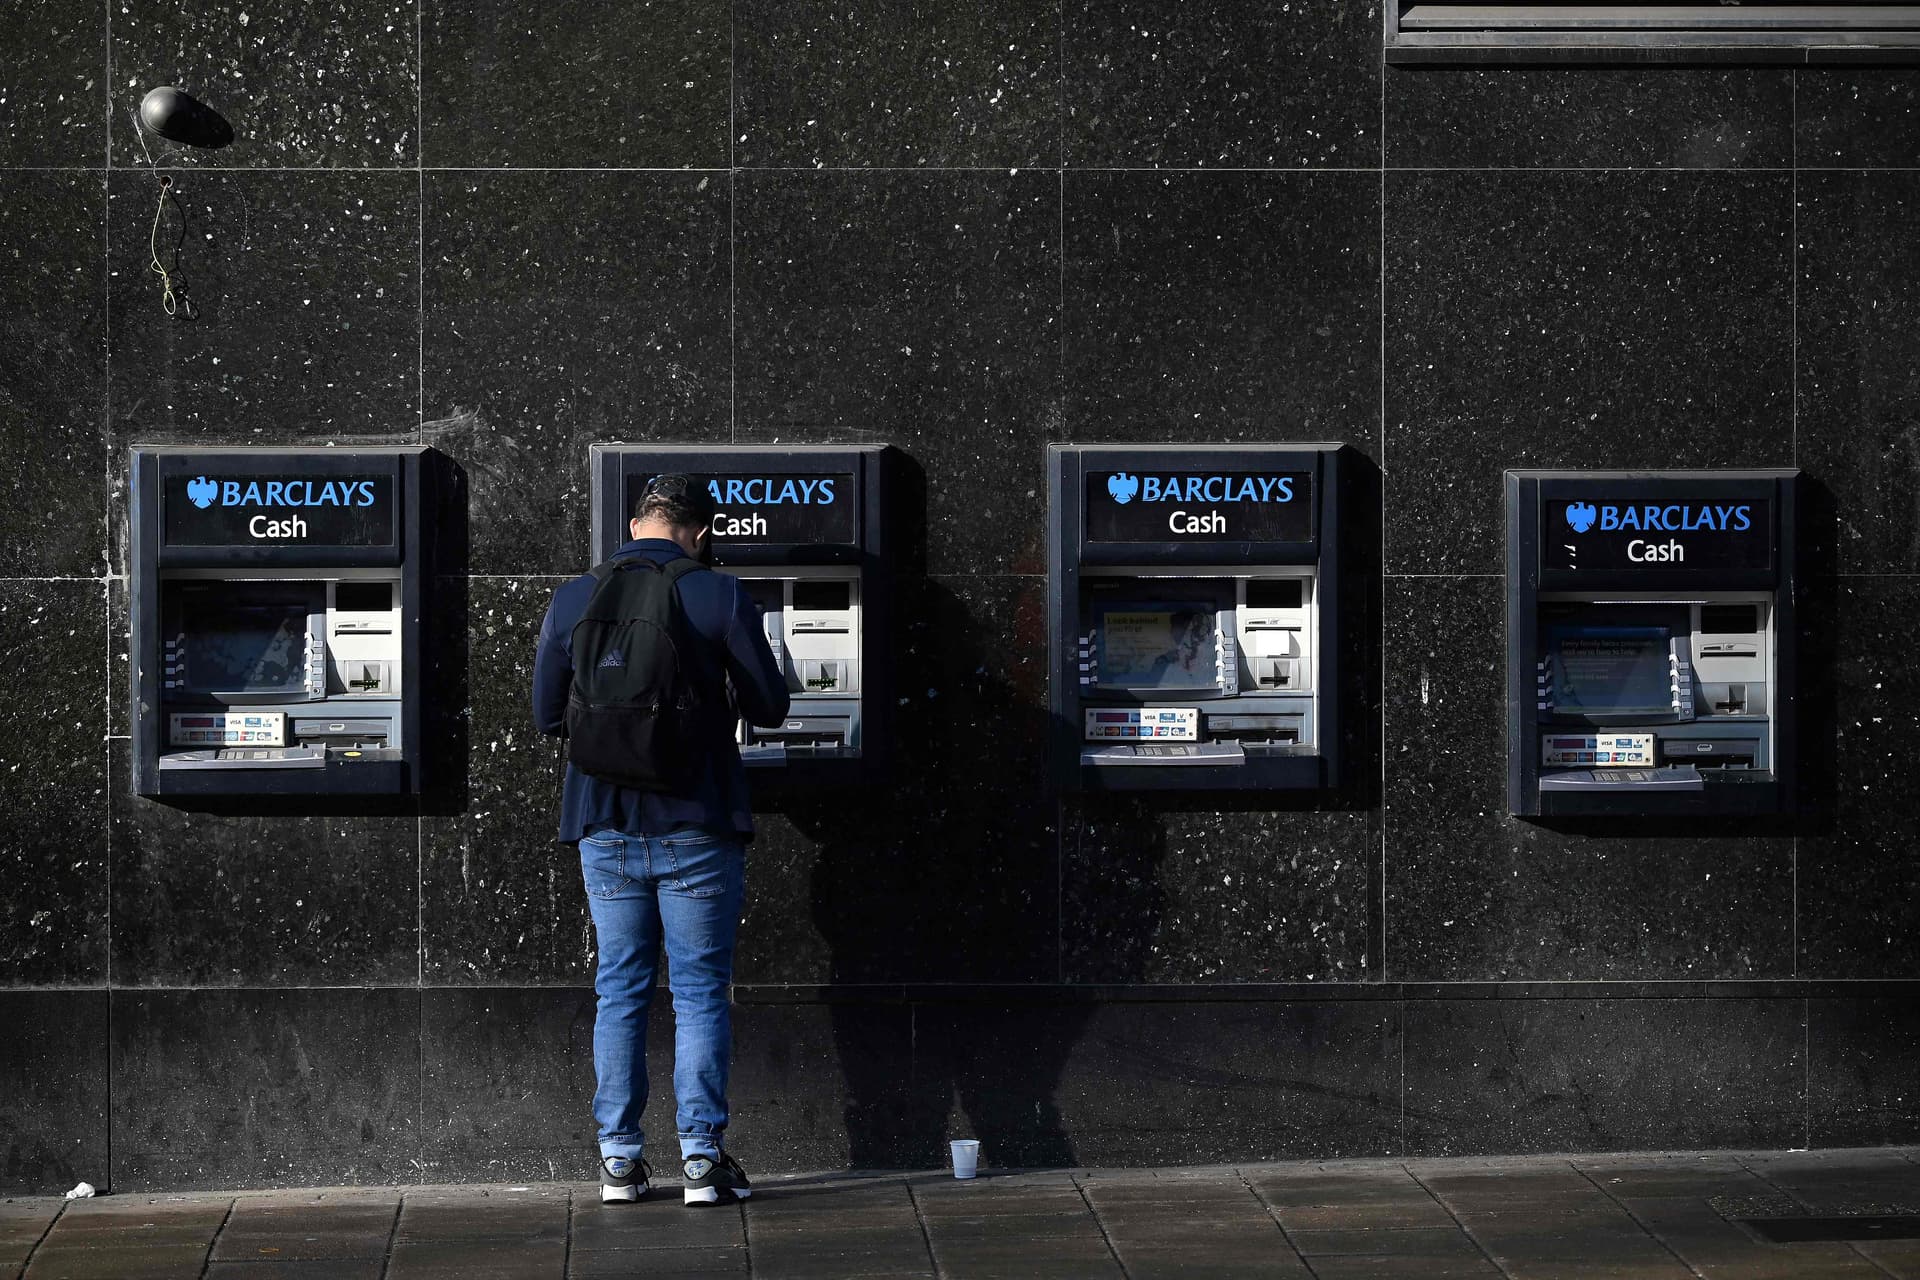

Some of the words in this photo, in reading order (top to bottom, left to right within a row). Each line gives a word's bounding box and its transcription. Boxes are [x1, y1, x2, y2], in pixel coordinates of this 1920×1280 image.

[221, 480, 375, 507] BARCLAYS
[707, 478, 835, 505] ARCLAYS
[1142, 476, 1294, 503] BARCLAYS
[249, 514, 307, 539] Cash
[711, 512, 767, 537] Cash
[1168, 509, 1226, 534] Cash
[1599, 505, 1751, 531] BARCLAYS
[1627, 538, 1684, 562] Cash
